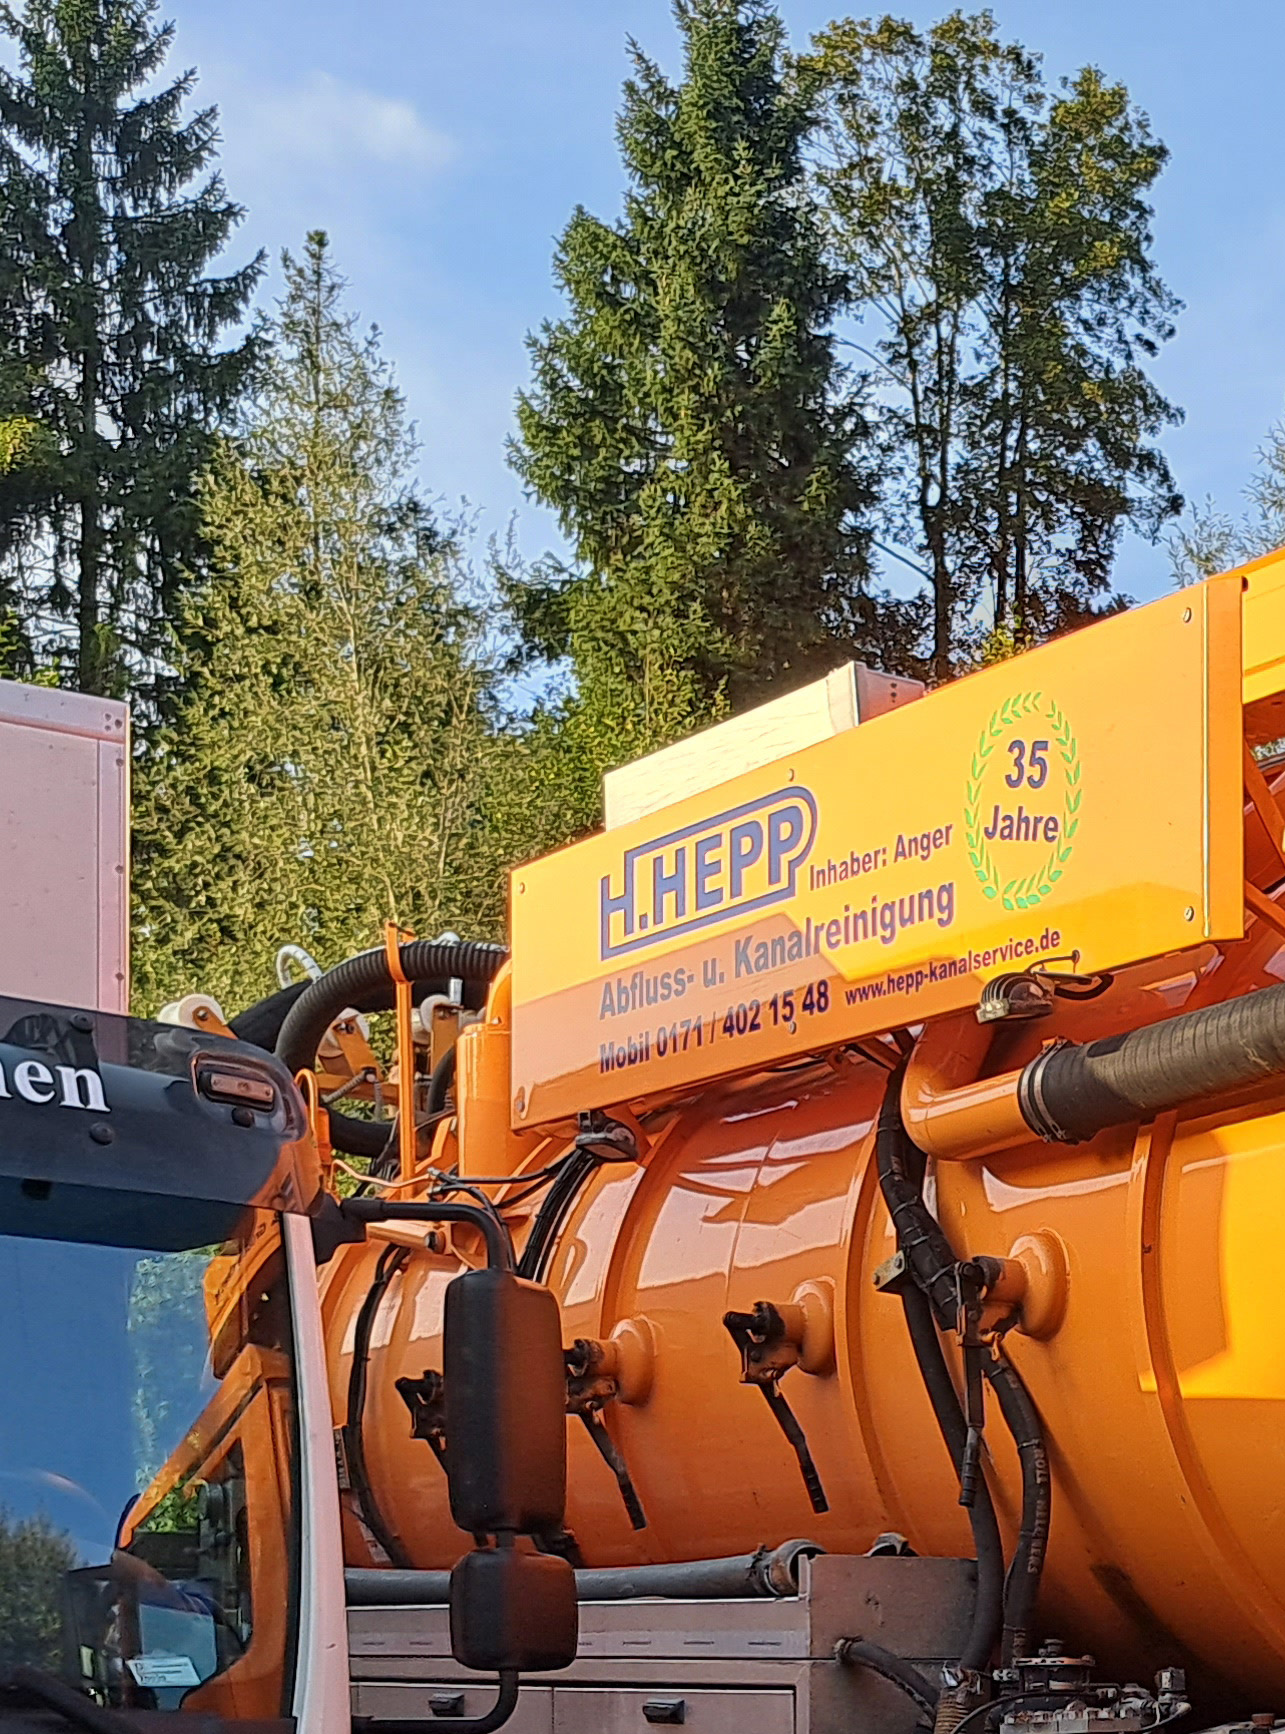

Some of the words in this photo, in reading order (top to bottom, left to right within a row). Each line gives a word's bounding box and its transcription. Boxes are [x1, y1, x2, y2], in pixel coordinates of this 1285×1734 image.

[1003, 739, 1051, 790] 35
[809, 846, 888, 891] Inhaber:
[893, 823, 954, 864] Anger
[984, 804, 1059, 845] Jahre
[600, 785, 818, 962] H.HEPP
[599, 966, 694, 1020] Abfluss-
[702, 957, 726, 989] u.
[734, 881, 955, 979] Kanalreinigung
[844, 928, 1061, 1006] www.hepp-kanalservice.de
[599, 1021, 651, 1074] Mobil
[655, 1014, 704, 1057] 0171
[722, 999, 762, 1038] 402
[768, 989, 795, 1026] 15
[801, 979, 831, 1016] 48
